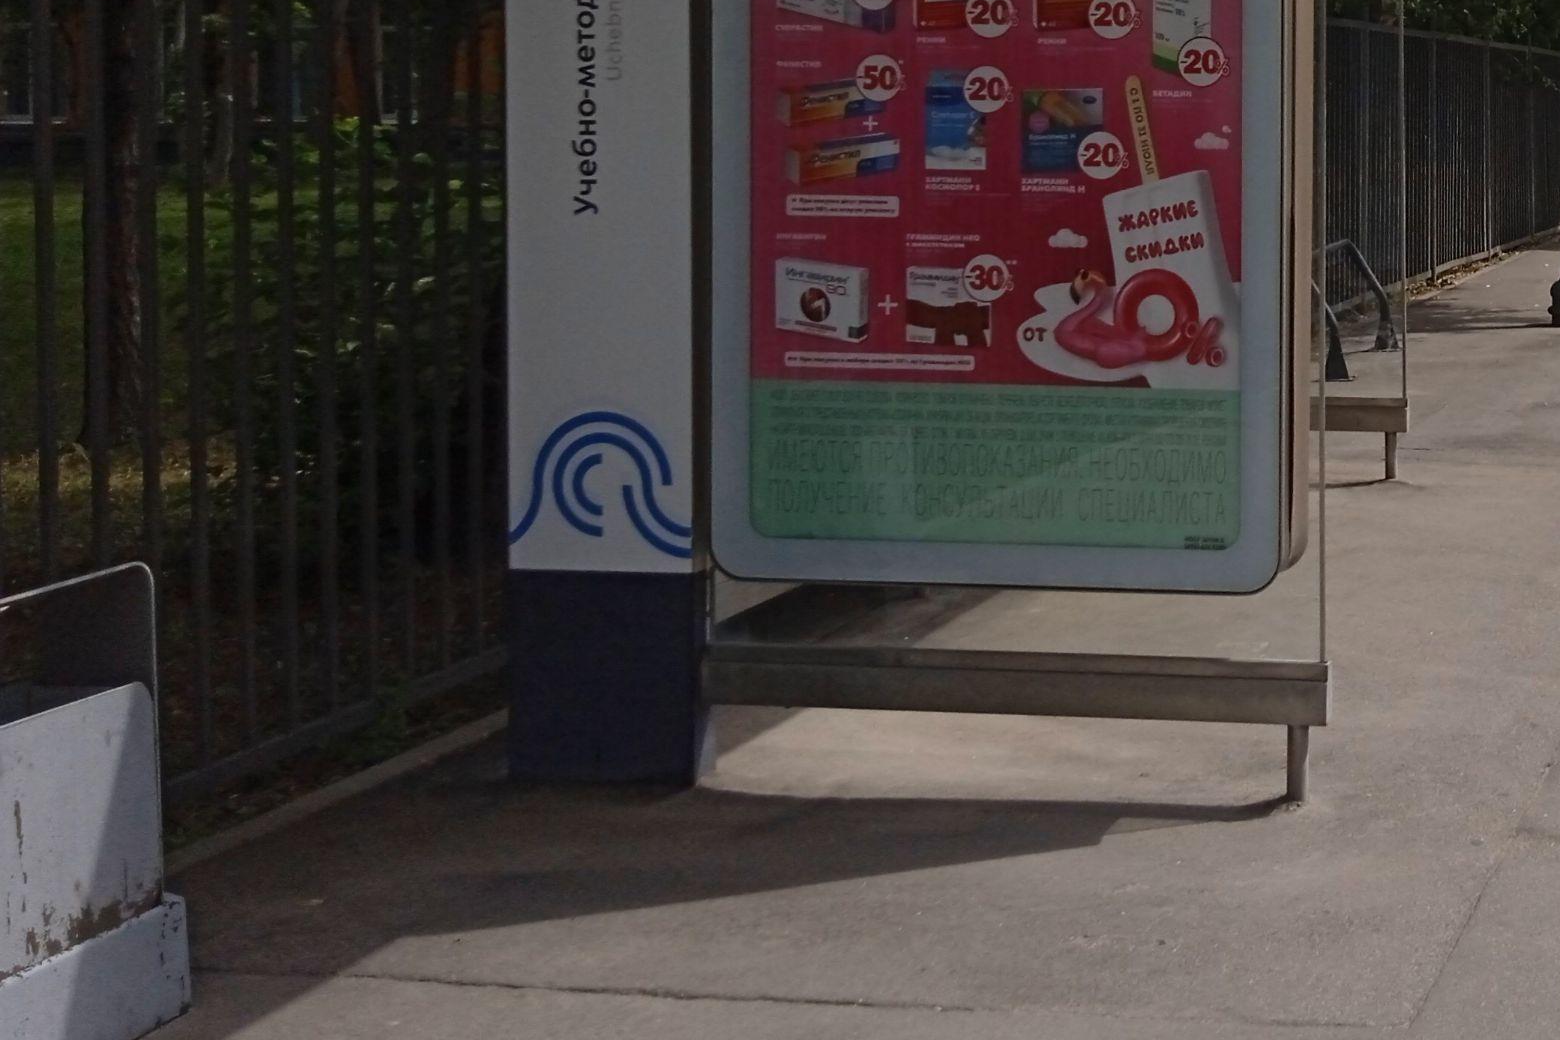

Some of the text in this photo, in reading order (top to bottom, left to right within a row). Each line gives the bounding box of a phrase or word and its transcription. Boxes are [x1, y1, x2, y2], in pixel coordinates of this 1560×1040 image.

[1118, 200, 1199, 233] ЖАРКИЕ
[1124, 232, 1205, 263] СКИДКИ
[1088, 447, 1227, 486] НЕОБХОДИМО
[1077, 487, 1227, 526] СПЕЦИАЛИСТА
